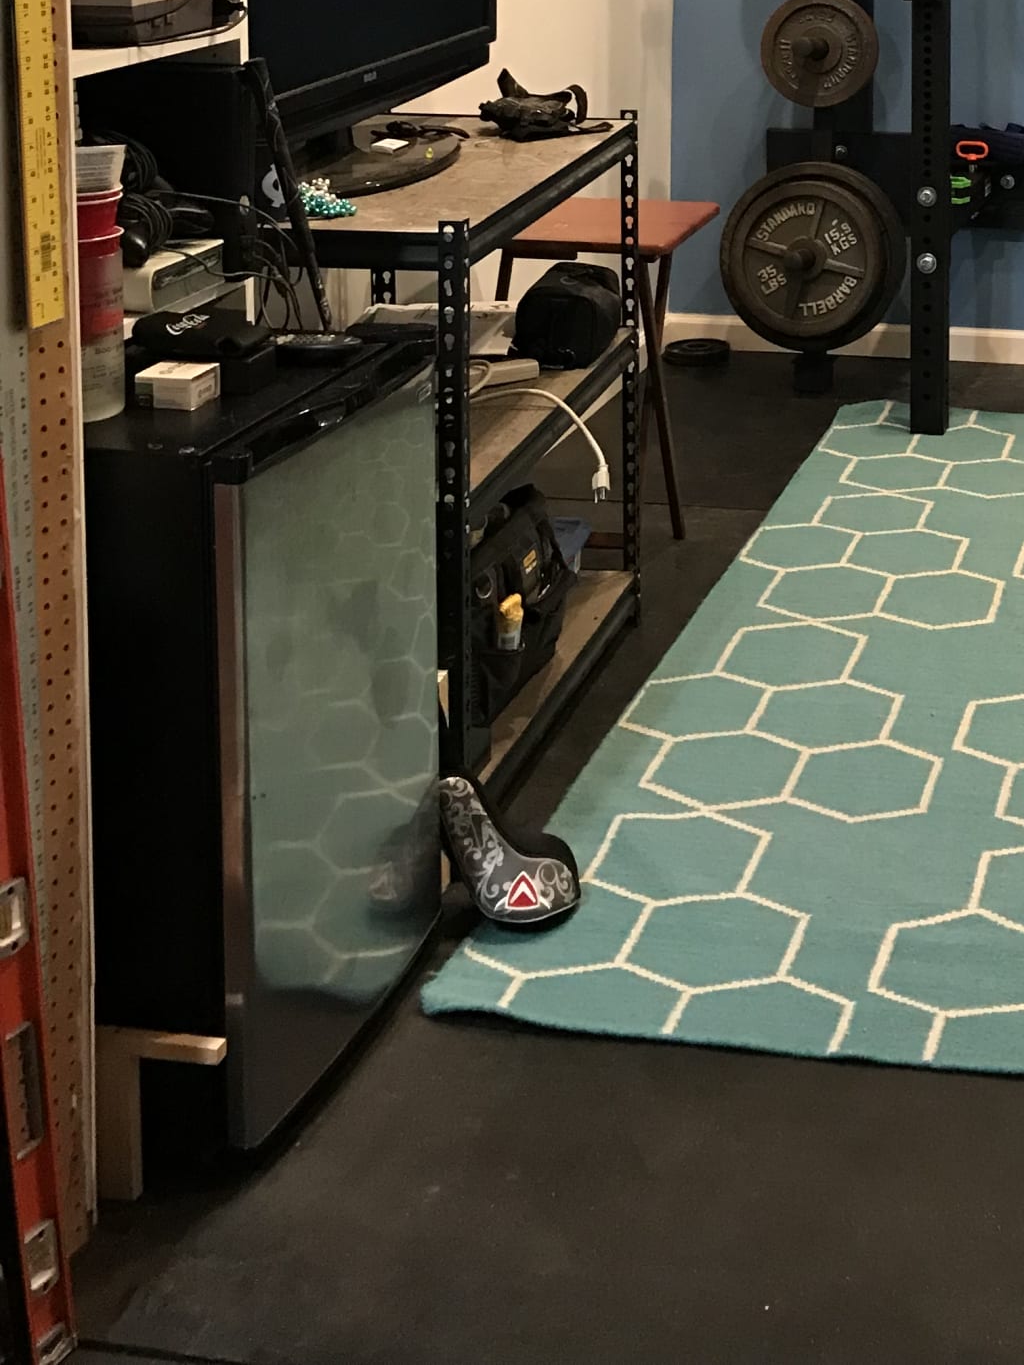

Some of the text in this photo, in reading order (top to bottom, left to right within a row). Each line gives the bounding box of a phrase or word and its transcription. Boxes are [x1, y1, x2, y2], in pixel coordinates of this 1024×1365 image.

[756, 202, 816, 242] STANDARD
[830, 233, 858, 255] KGS
[757, 264, 777, 282] 35
[761, 274, 788, 295] LBS
[798, 275, 858, 317] BARBELL
